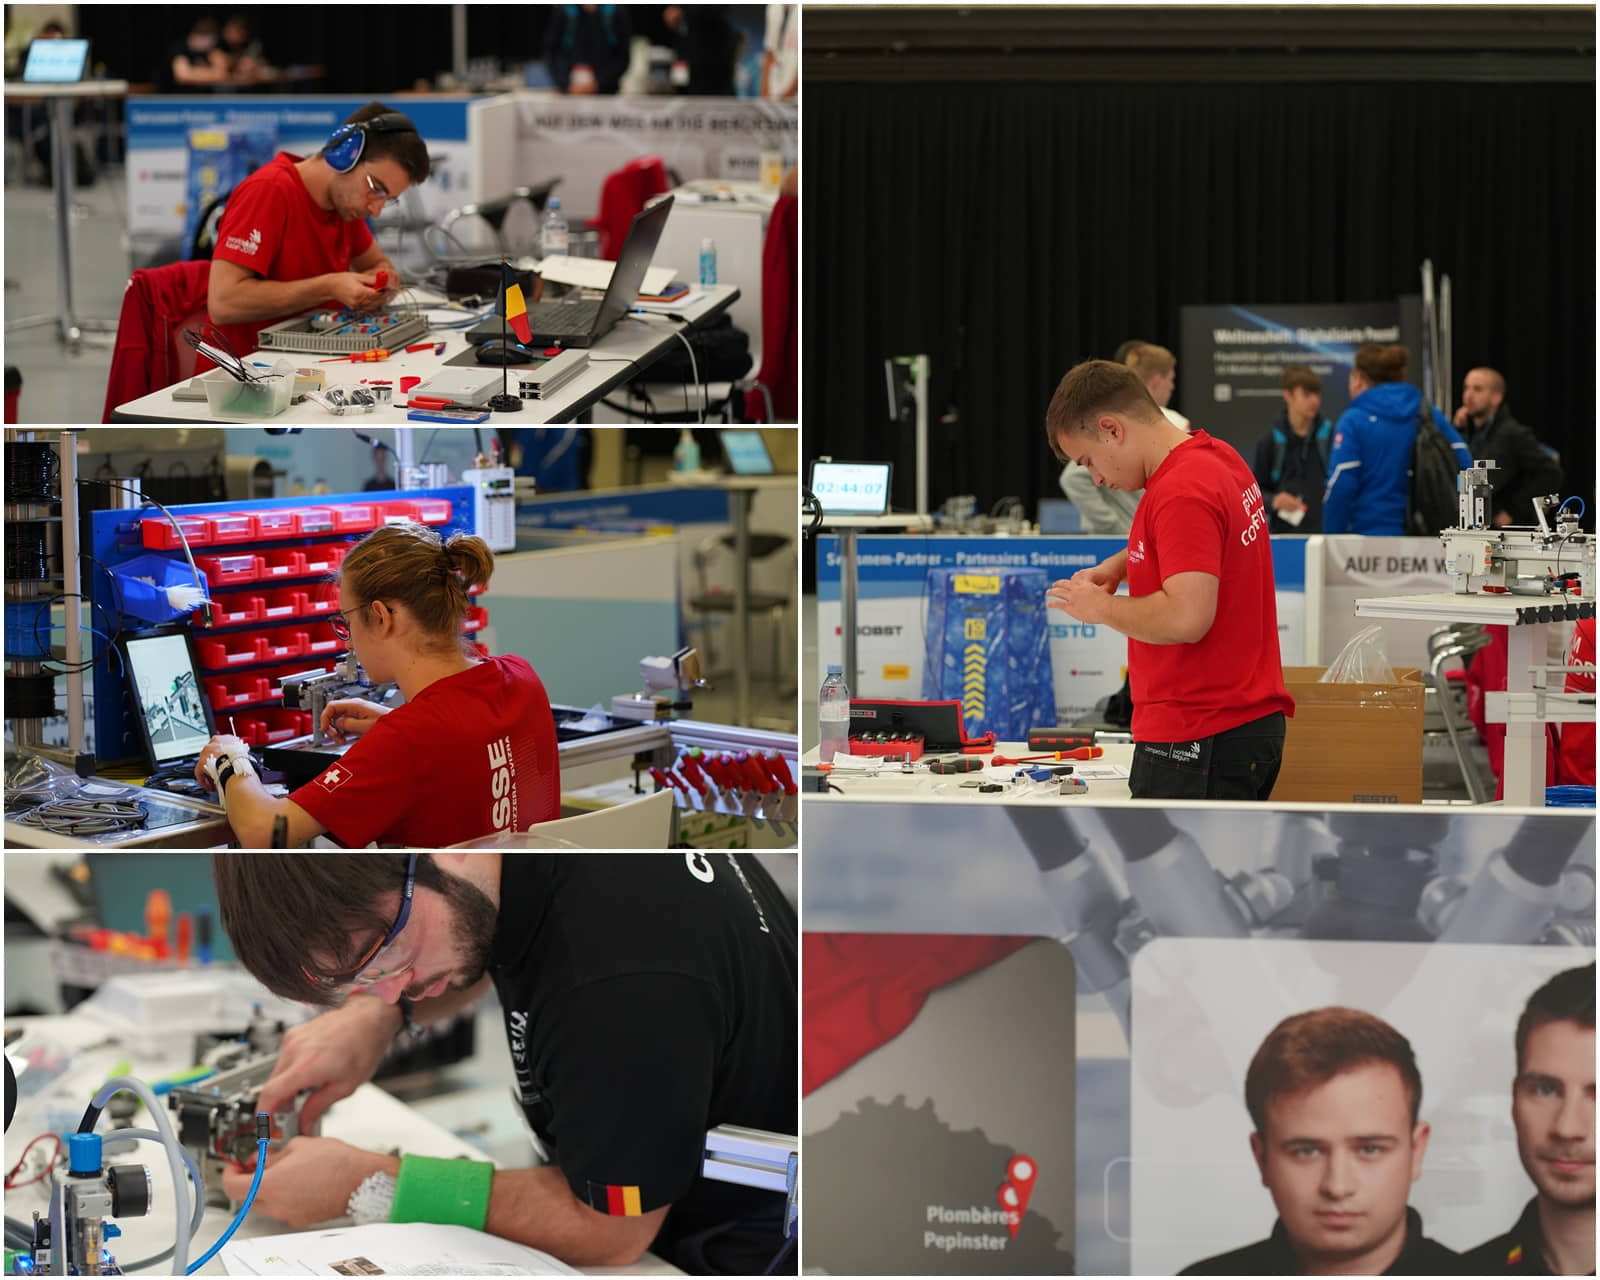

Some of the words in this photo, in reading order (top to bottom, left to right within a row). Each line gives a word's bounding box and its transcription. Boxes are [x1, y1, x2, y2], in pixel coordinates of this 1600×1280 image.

[1344, 556, 1381, 573] AUF
[1386, 556, 1428, 573] DEM
[857, 625, 903, 636] OBST
[1048, 623, 1097, 638] ESTO
[926, 1205, 1020, 1224] Plombères
[924, 1231, 1008, 1253] Pepinster
